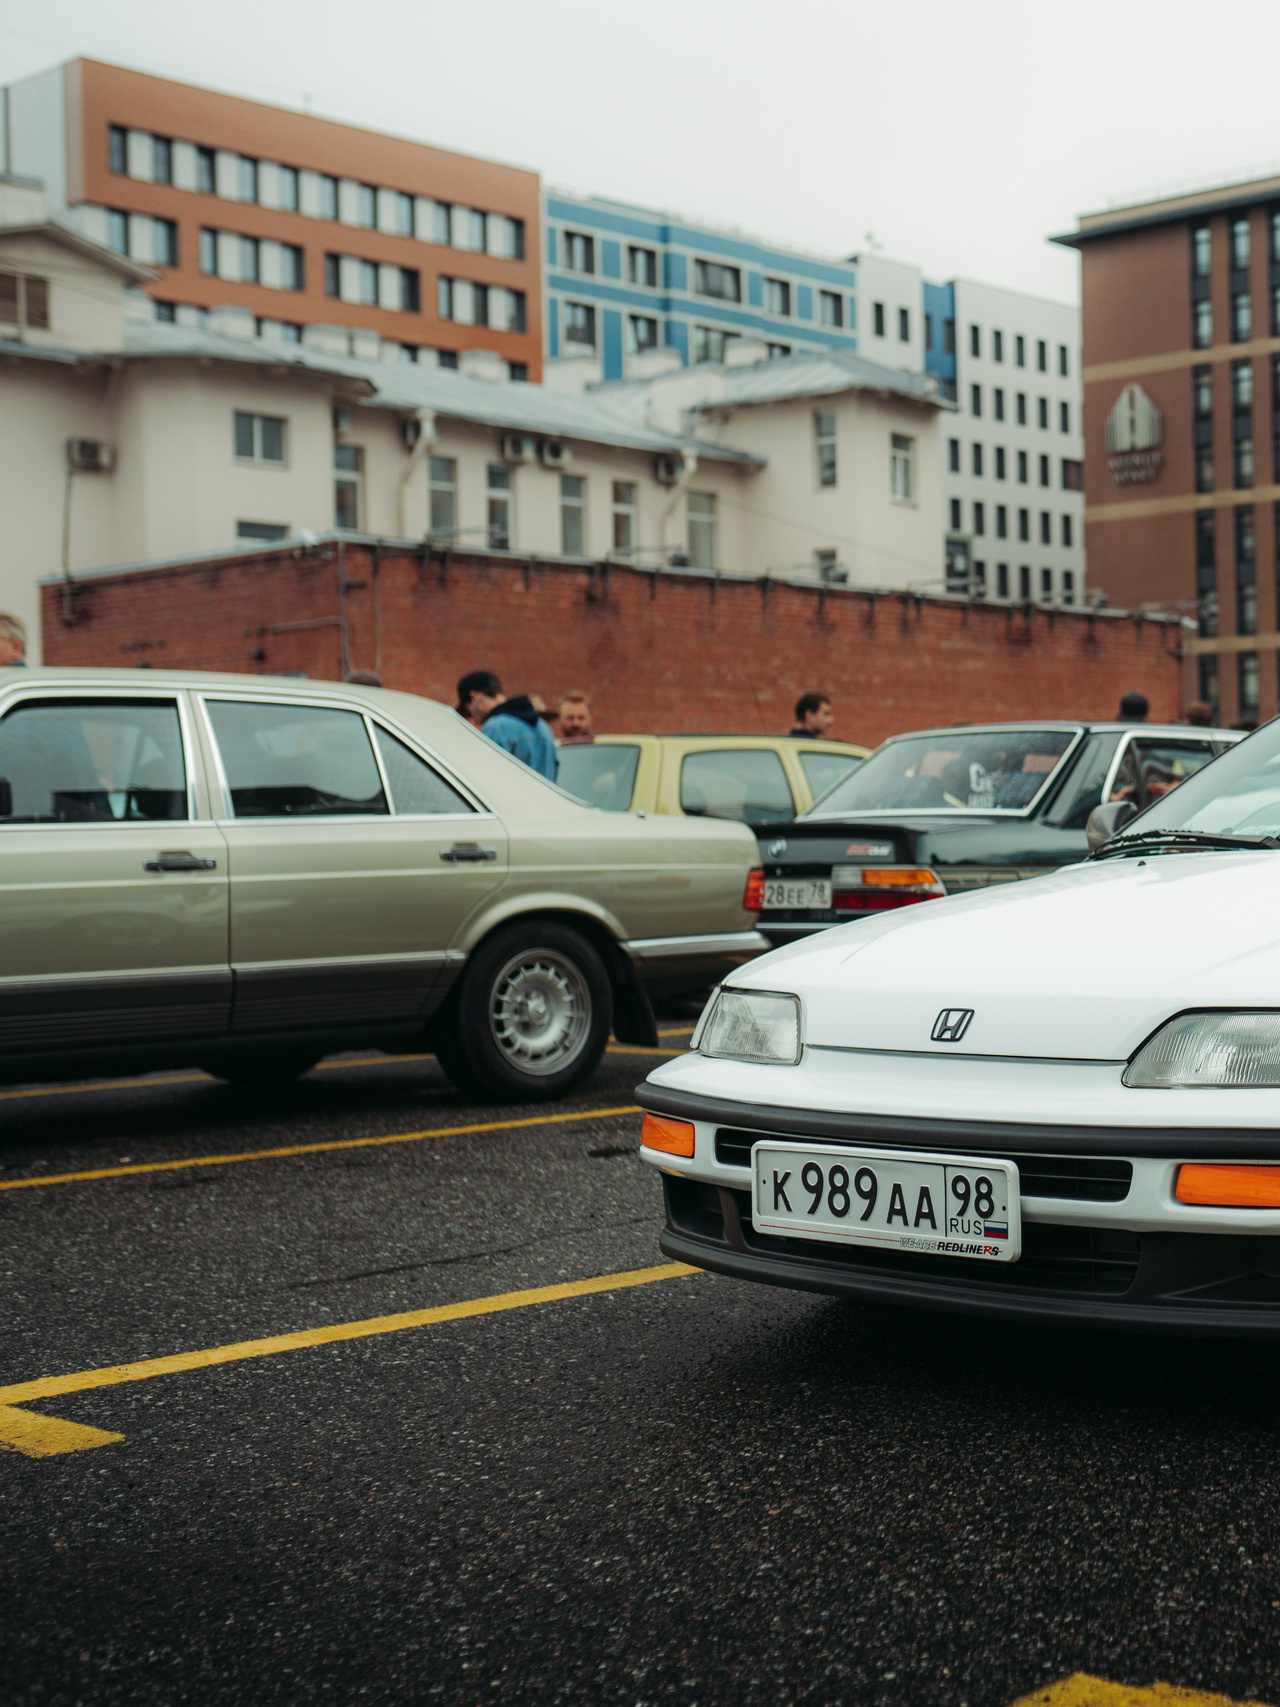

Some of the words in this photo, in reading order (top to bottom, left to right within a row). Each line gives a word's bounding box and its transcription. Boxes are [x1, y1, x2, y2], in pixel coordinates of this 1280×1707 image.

[764, 884, 805, 905] 28EE
[951, 1174, 995, 1220] 98
[950, 1217, 982, 1236] RUS
[937, 1241, 999, 1256] REDLINERS
